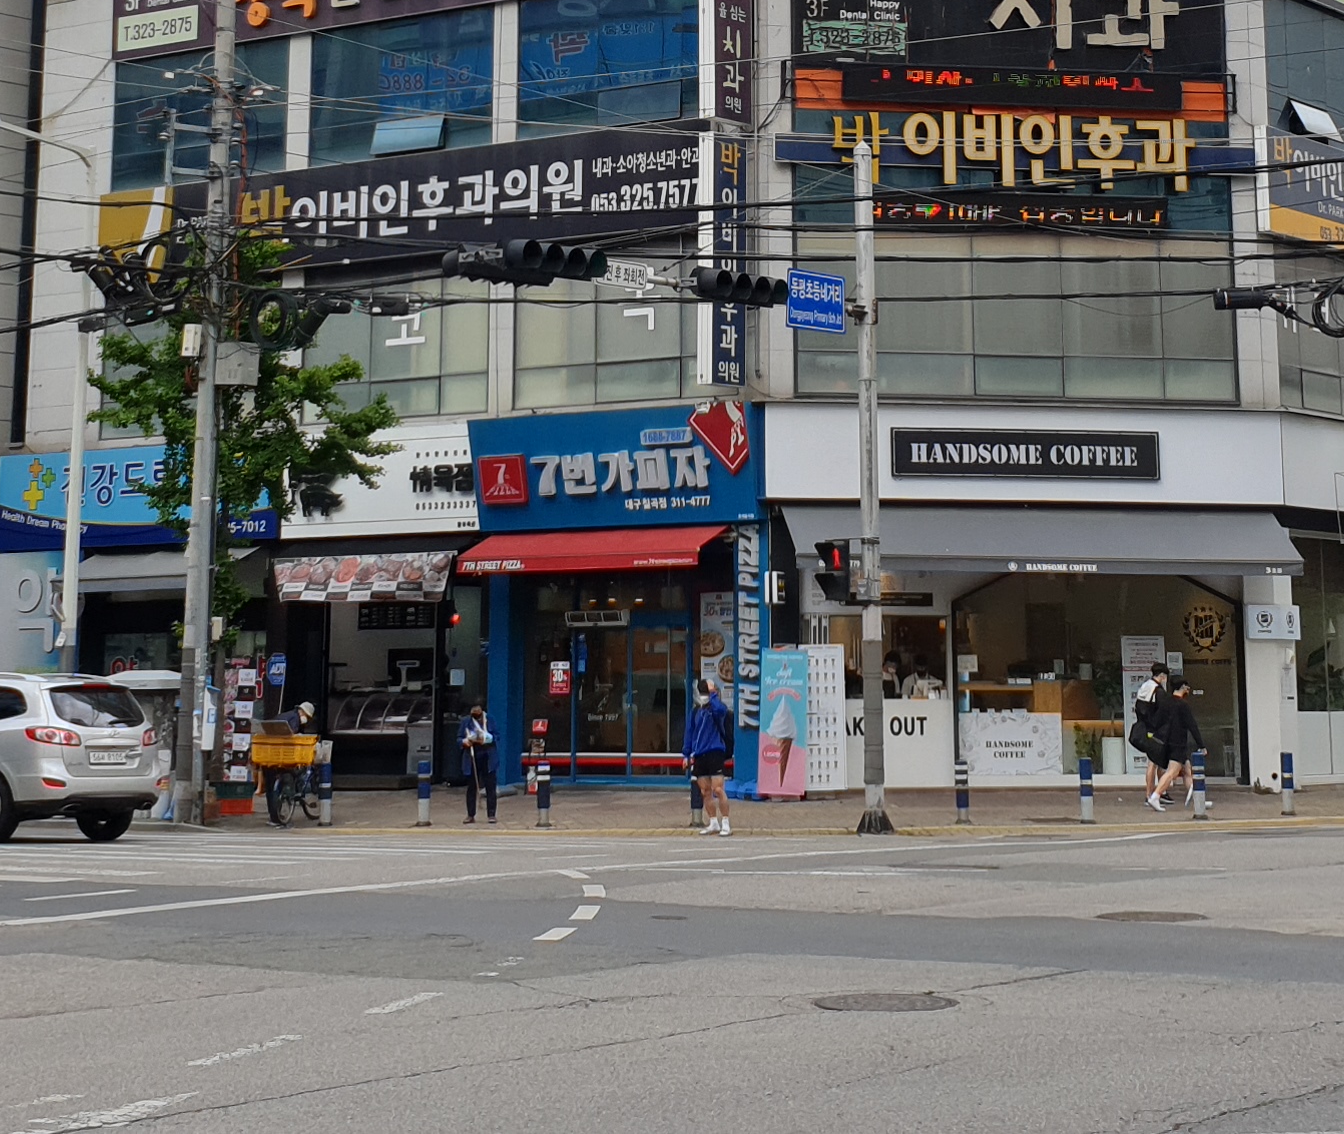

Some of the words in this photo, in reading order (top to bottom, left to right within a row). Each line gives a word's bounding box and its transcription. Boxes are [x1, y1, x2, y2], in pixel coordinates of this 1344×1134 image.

[839, 10, 869, 21] Dental
[873, 10, 901, 21] Clinic
[124, 16, 193, 41] T.323-2875
[723, 93, 744, 115] 의원
[790, 277, 842, 304] 동평초등네거리
[718, 361, 740, 383] 의원
[910, 441, 1043, 466] HANDSOME
[1049, 443, 1138, 467] COFFEE
[529, 445, 711, 497] 7번가피자
[671, 496, 711, 508] 311-4777
[1, 510, 25, 524] Health
[26, 515, 50, 528] Dream
[477, 560, 502, 571] STREET
[737, 525, 760, 589] PIZZA
[1025, 562, 1066, 572] HANDSOME
[1067, 563, 1098, 573] COFFEE
[737, 594, 760, 680] STREET
[890, 716, 928, 738] OUT
[985, 739, 1034, 750] HANDSOME
[992, 750, 1026, 759] COFFEE
